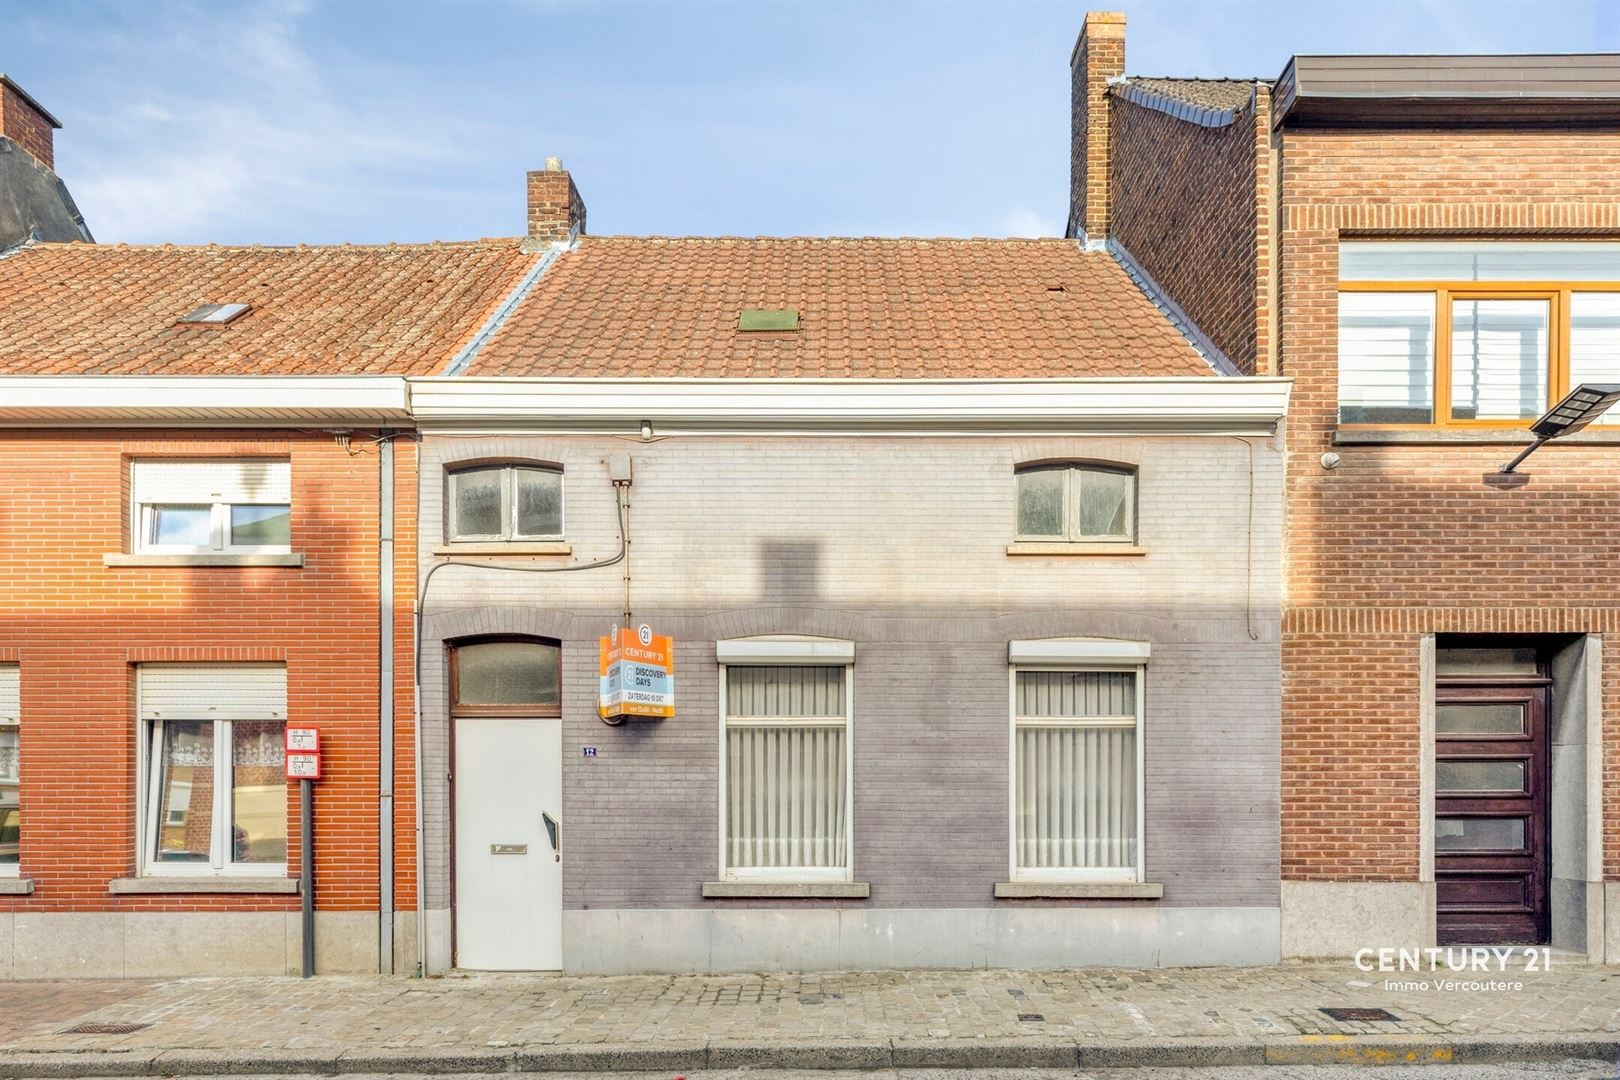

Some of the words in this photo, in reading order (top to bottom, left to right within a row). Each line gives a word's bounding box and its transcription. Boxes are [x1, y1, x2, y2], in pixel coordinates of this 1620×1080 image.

[625, 647, 657, 660] CENTURY
[657, 652, 664, 661] 21
[635, 667, 667, 679] DISCOVERY
[635, 677, 651, 687] DAYS
